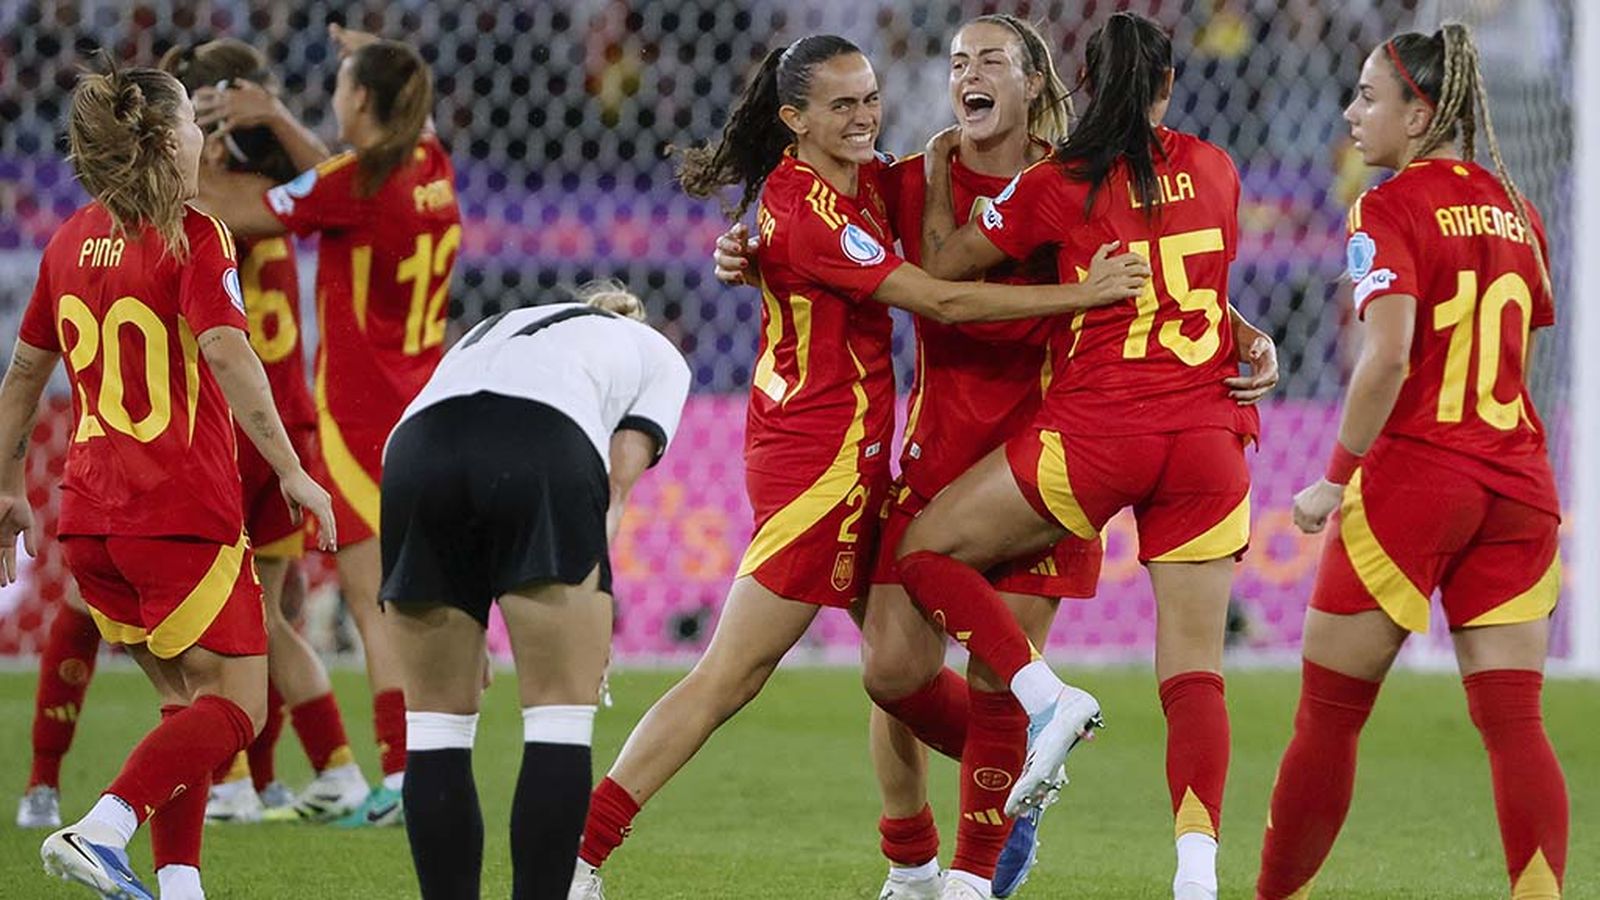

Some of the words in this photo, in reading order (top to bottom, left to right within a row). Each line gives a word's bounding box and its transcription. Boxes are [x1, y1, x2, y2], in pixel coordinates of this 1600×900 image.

[78, 237, 126, 268] PINA
[1127, 172, 1195, 208] LILA
[240, 236, 298, 364] 6
[396, 224, 462, 356] 12
[1122, 228, 1225, 367] 15
[1433, 270, 1534, 431] 10
[58, 294, 172, 444] 20
[837, 484, 868, 544] 2
